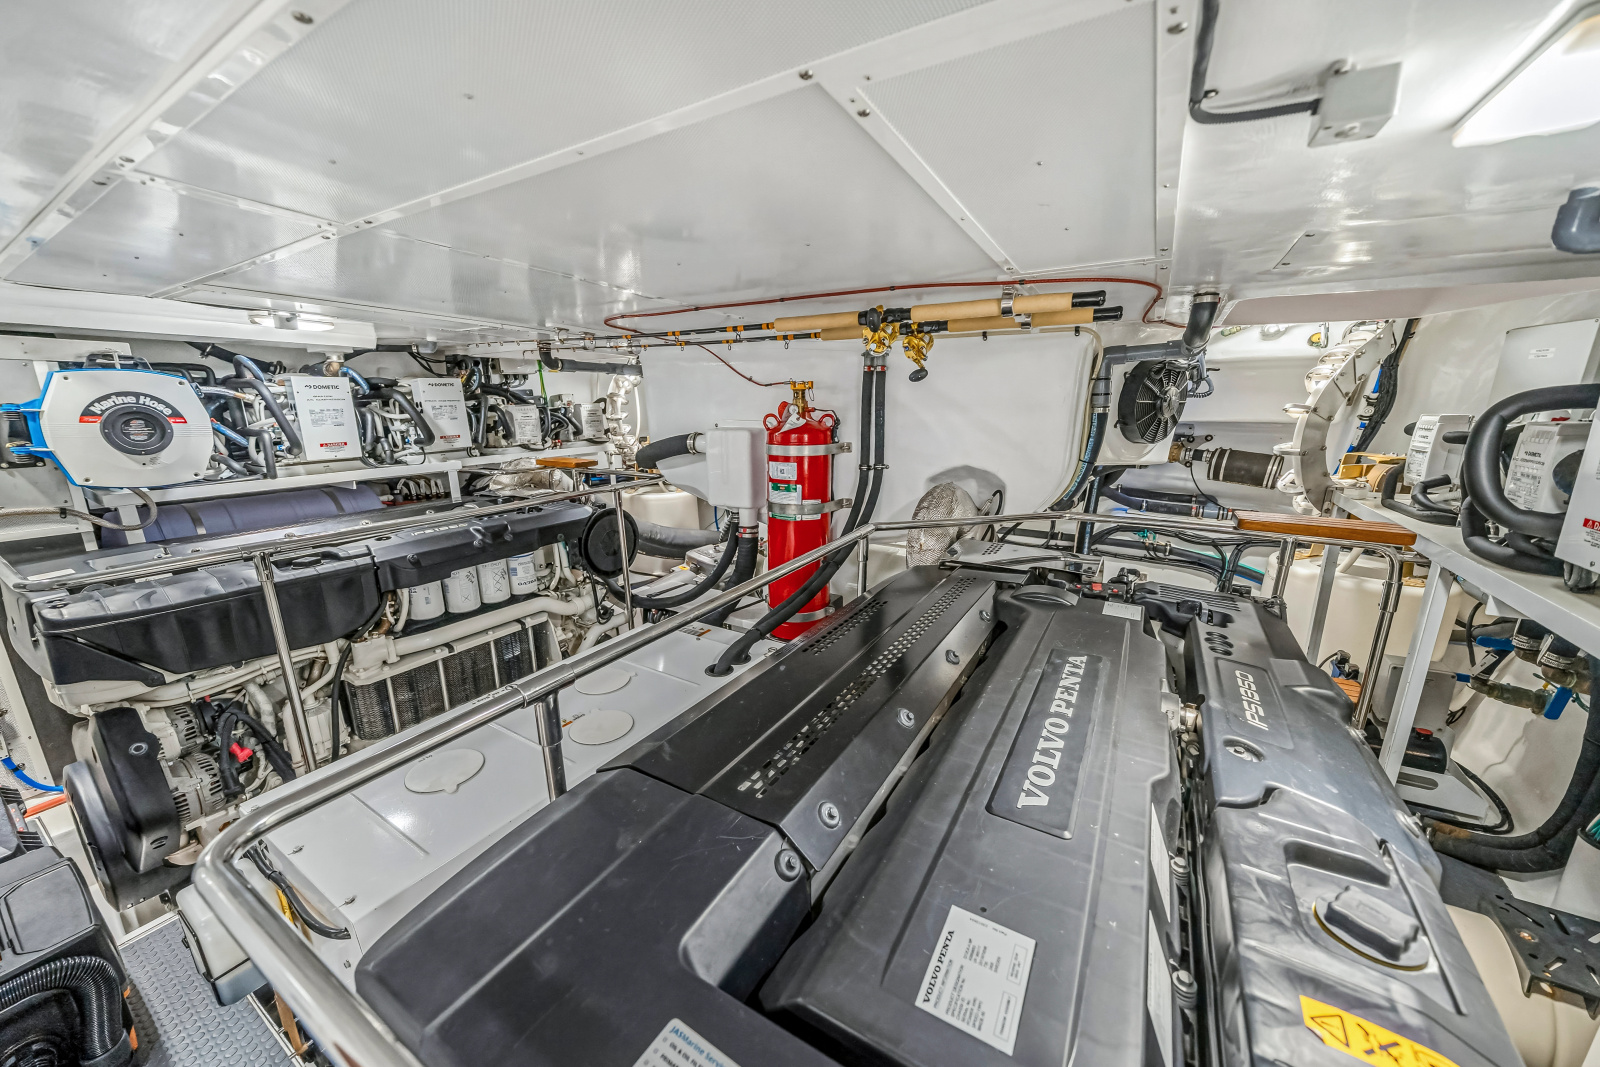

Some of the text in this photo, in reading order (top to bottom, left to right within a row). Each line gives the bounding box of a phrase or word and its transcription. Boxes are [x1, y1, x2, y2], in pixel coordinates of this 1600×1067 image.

[89, 395, 172, 416] Marine Hose
[1016, 655, 1088, 810] VOLVO PENTA
[922, 929, 955, 1004] VOLVO PENTA
[670, 1026, 704, 1056] JASMarine
